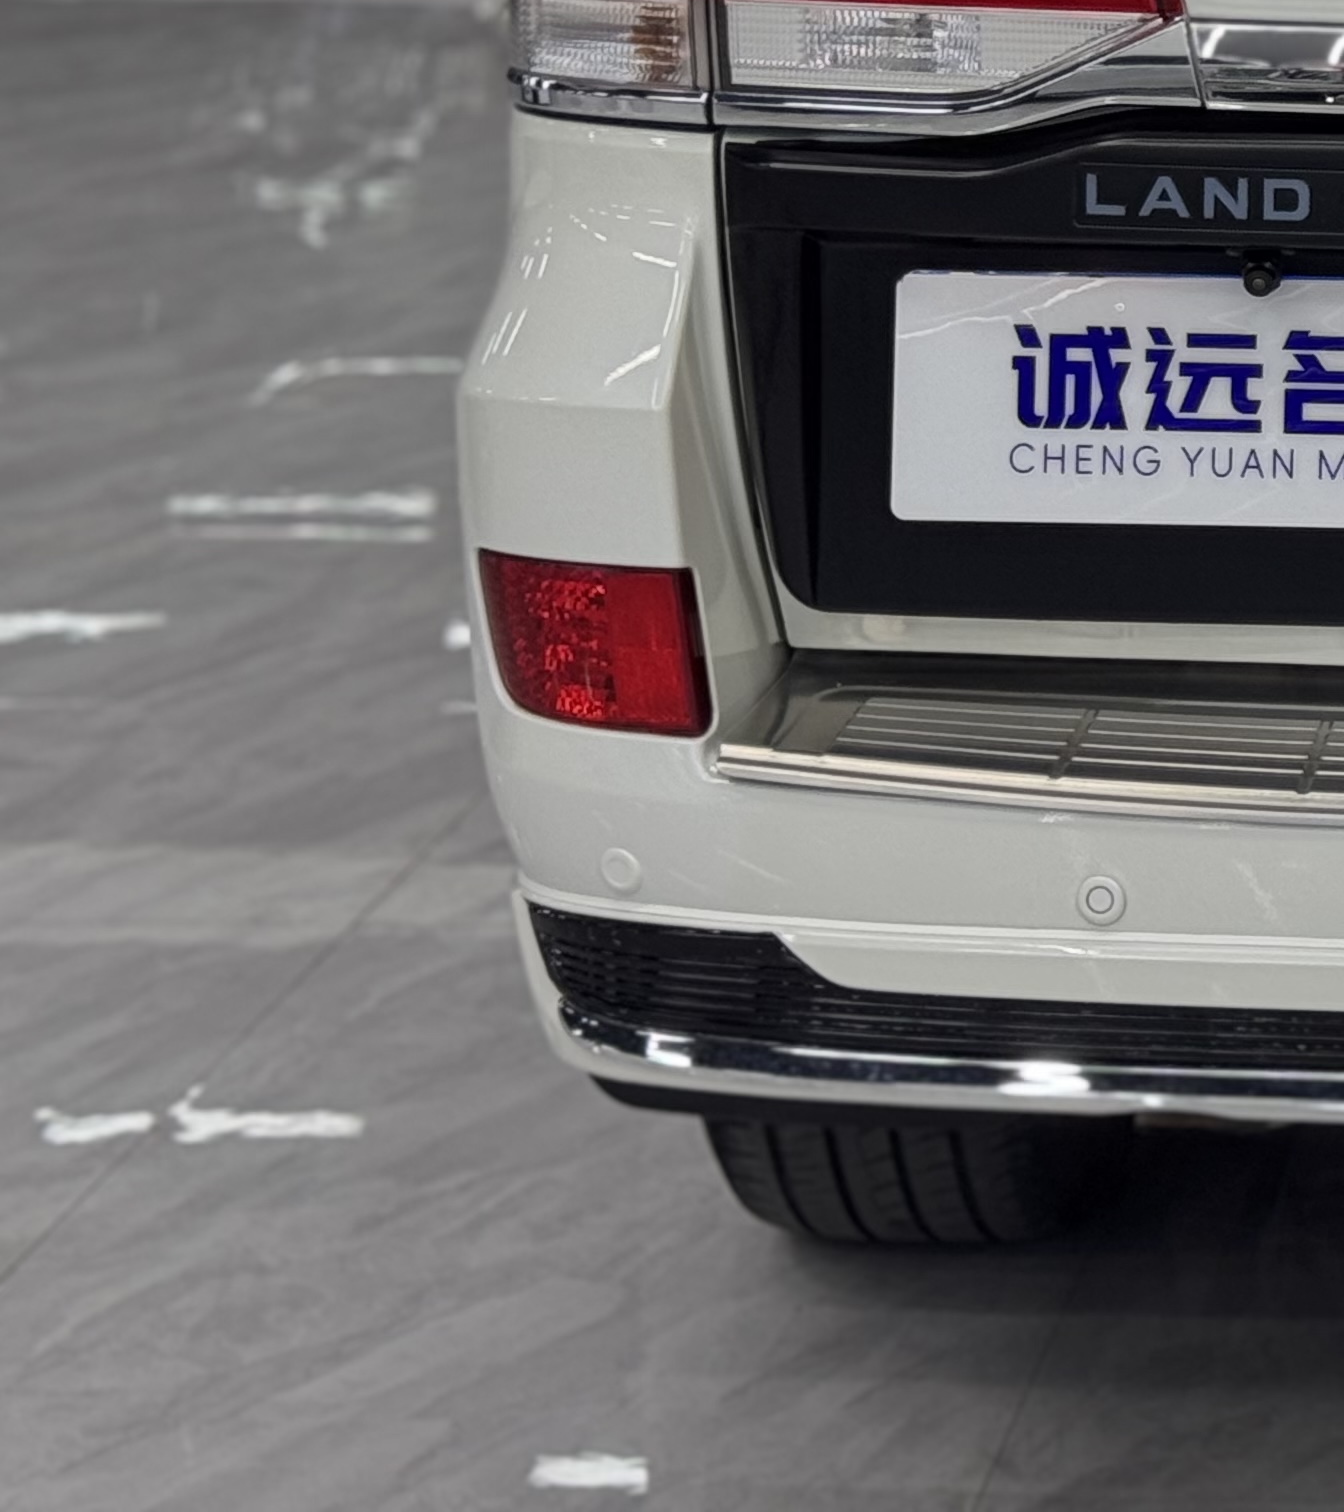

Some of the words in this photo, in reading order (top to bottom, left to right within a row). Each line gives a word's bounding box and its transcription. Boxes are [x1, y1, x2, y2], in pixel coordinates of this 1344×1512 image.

[1084, 173, 1312, 224] LAND
[1008, 442, 1162, 476] CHENG
[1180, 447, 1296, 480] YUAN
